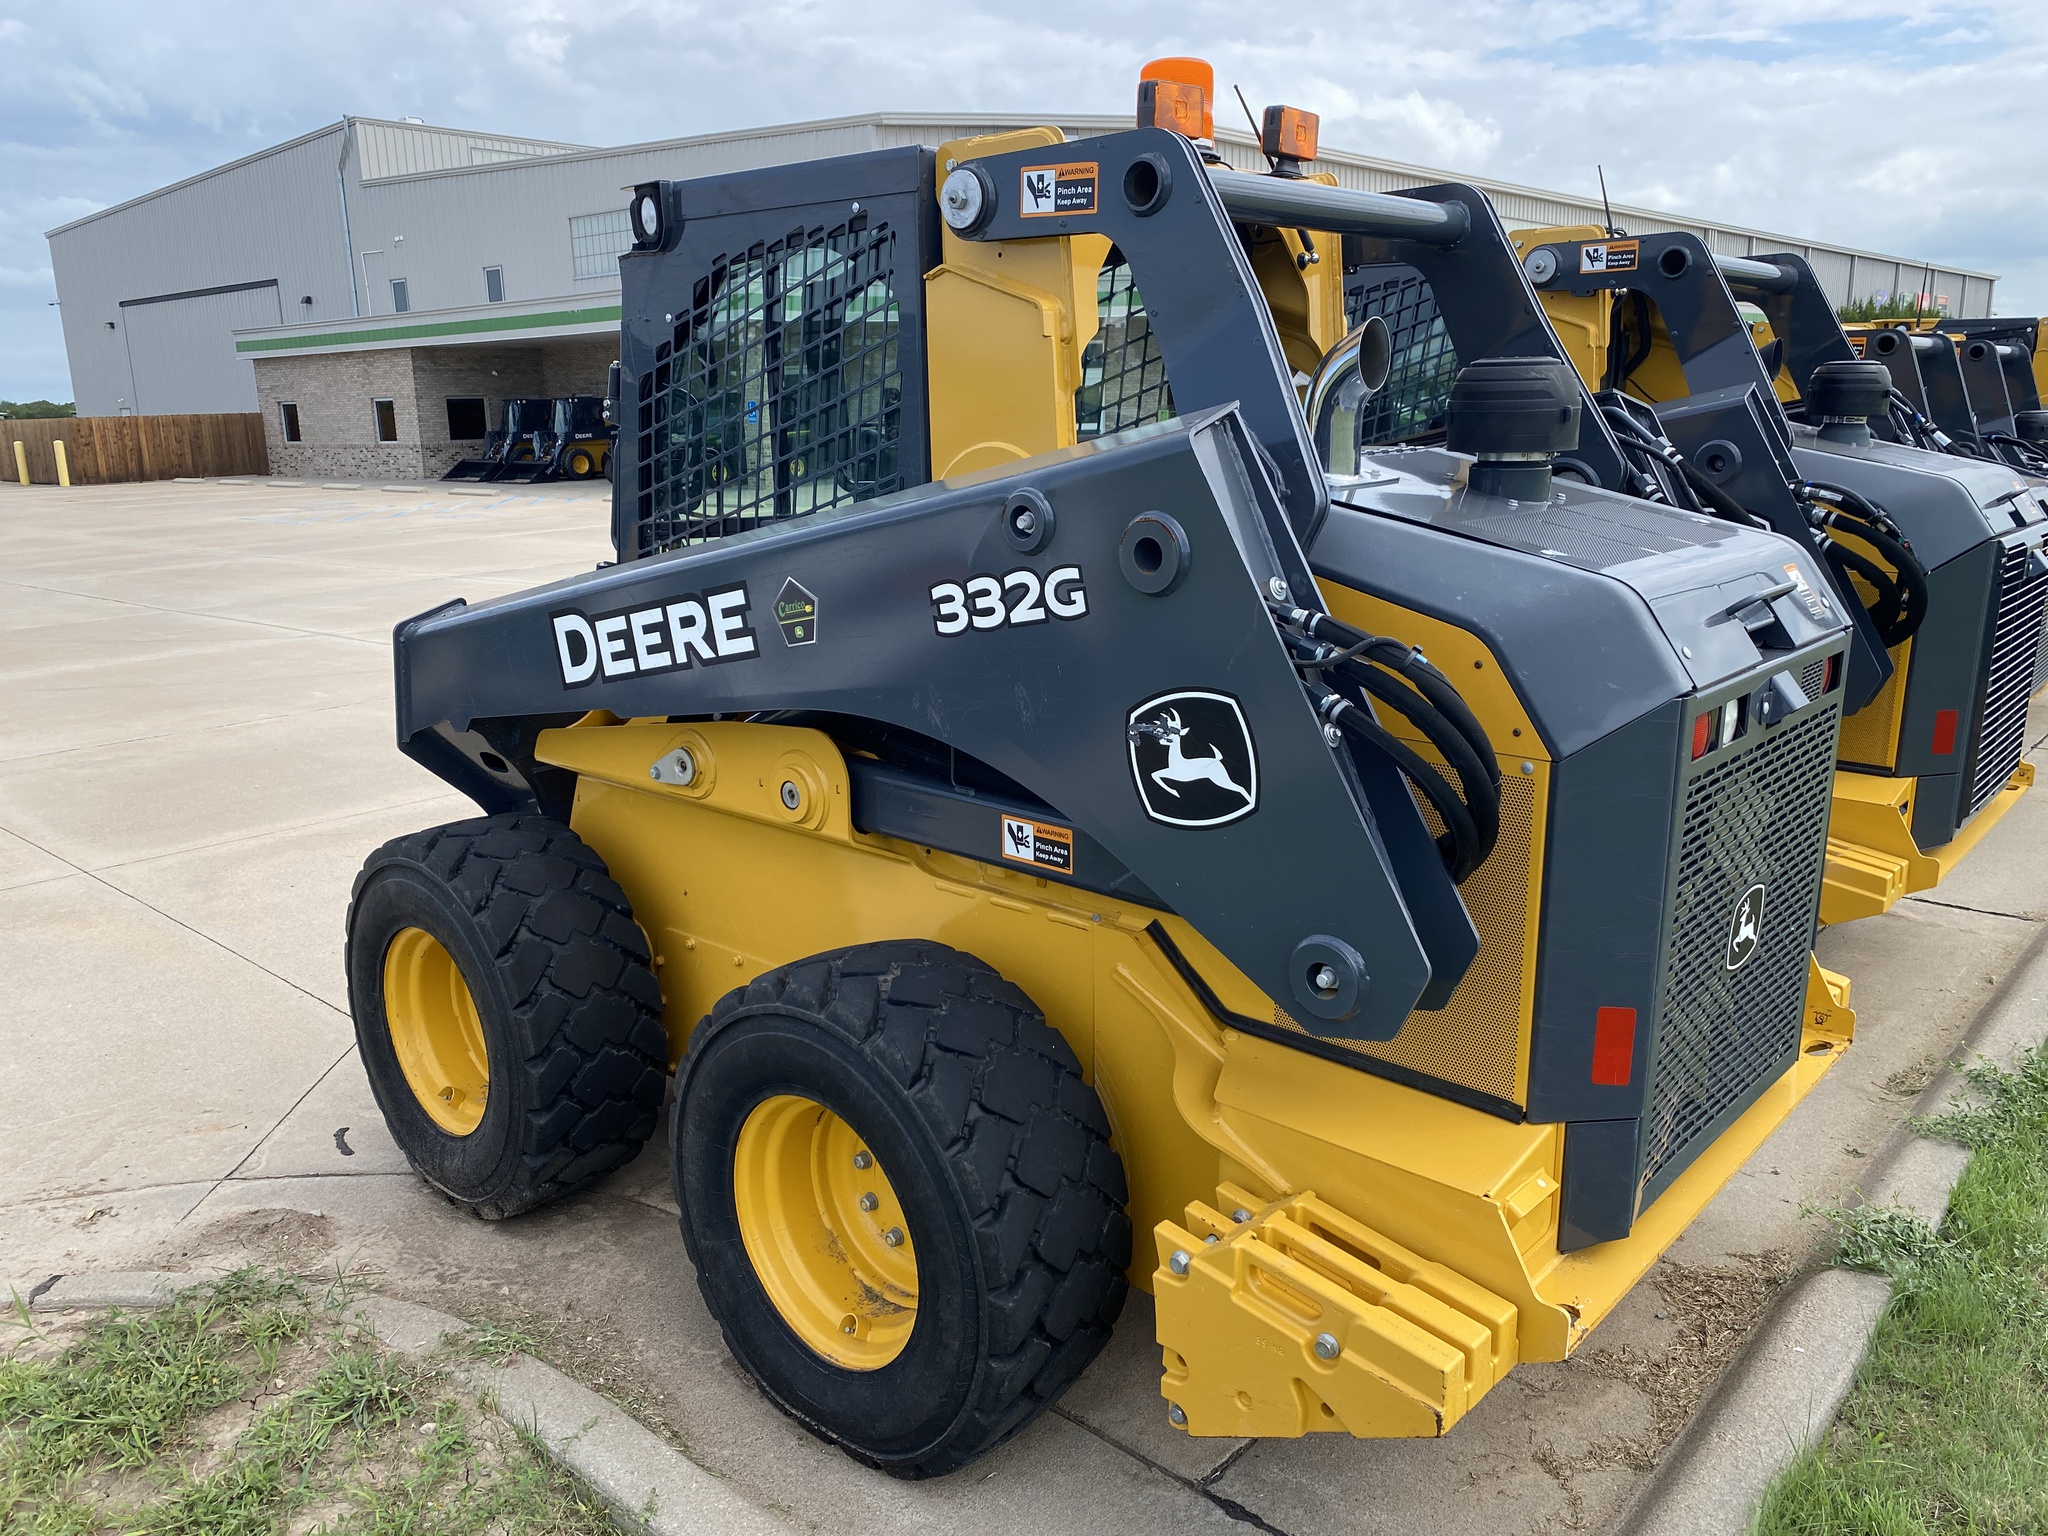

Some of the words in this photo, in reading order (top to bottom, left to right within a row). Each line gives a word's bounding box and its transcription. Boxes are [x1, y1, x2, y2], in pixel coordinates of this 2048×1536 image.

[1064, 166, 1094, 176] WARNING
[1057, 187, 1076, 196] Pinch
[1076, 186, 1092, 194] Area
[1057, 198, 1072, 206] Keep
[1072, 197, 1088, 205] Away
[930, 567, 1086, 634] 332G
[778, 600, 806, 618] Carrico
[553, 589, 755, 684] DEERE
[1042, 828, 1069, 840] WARNING
[1035, 841, 1052, 852] Pinch
[1053, 846, 1068, 856] Area
[1035, 851, 1049, 860] Keep
[1049, 854, 1064, 864] Away
